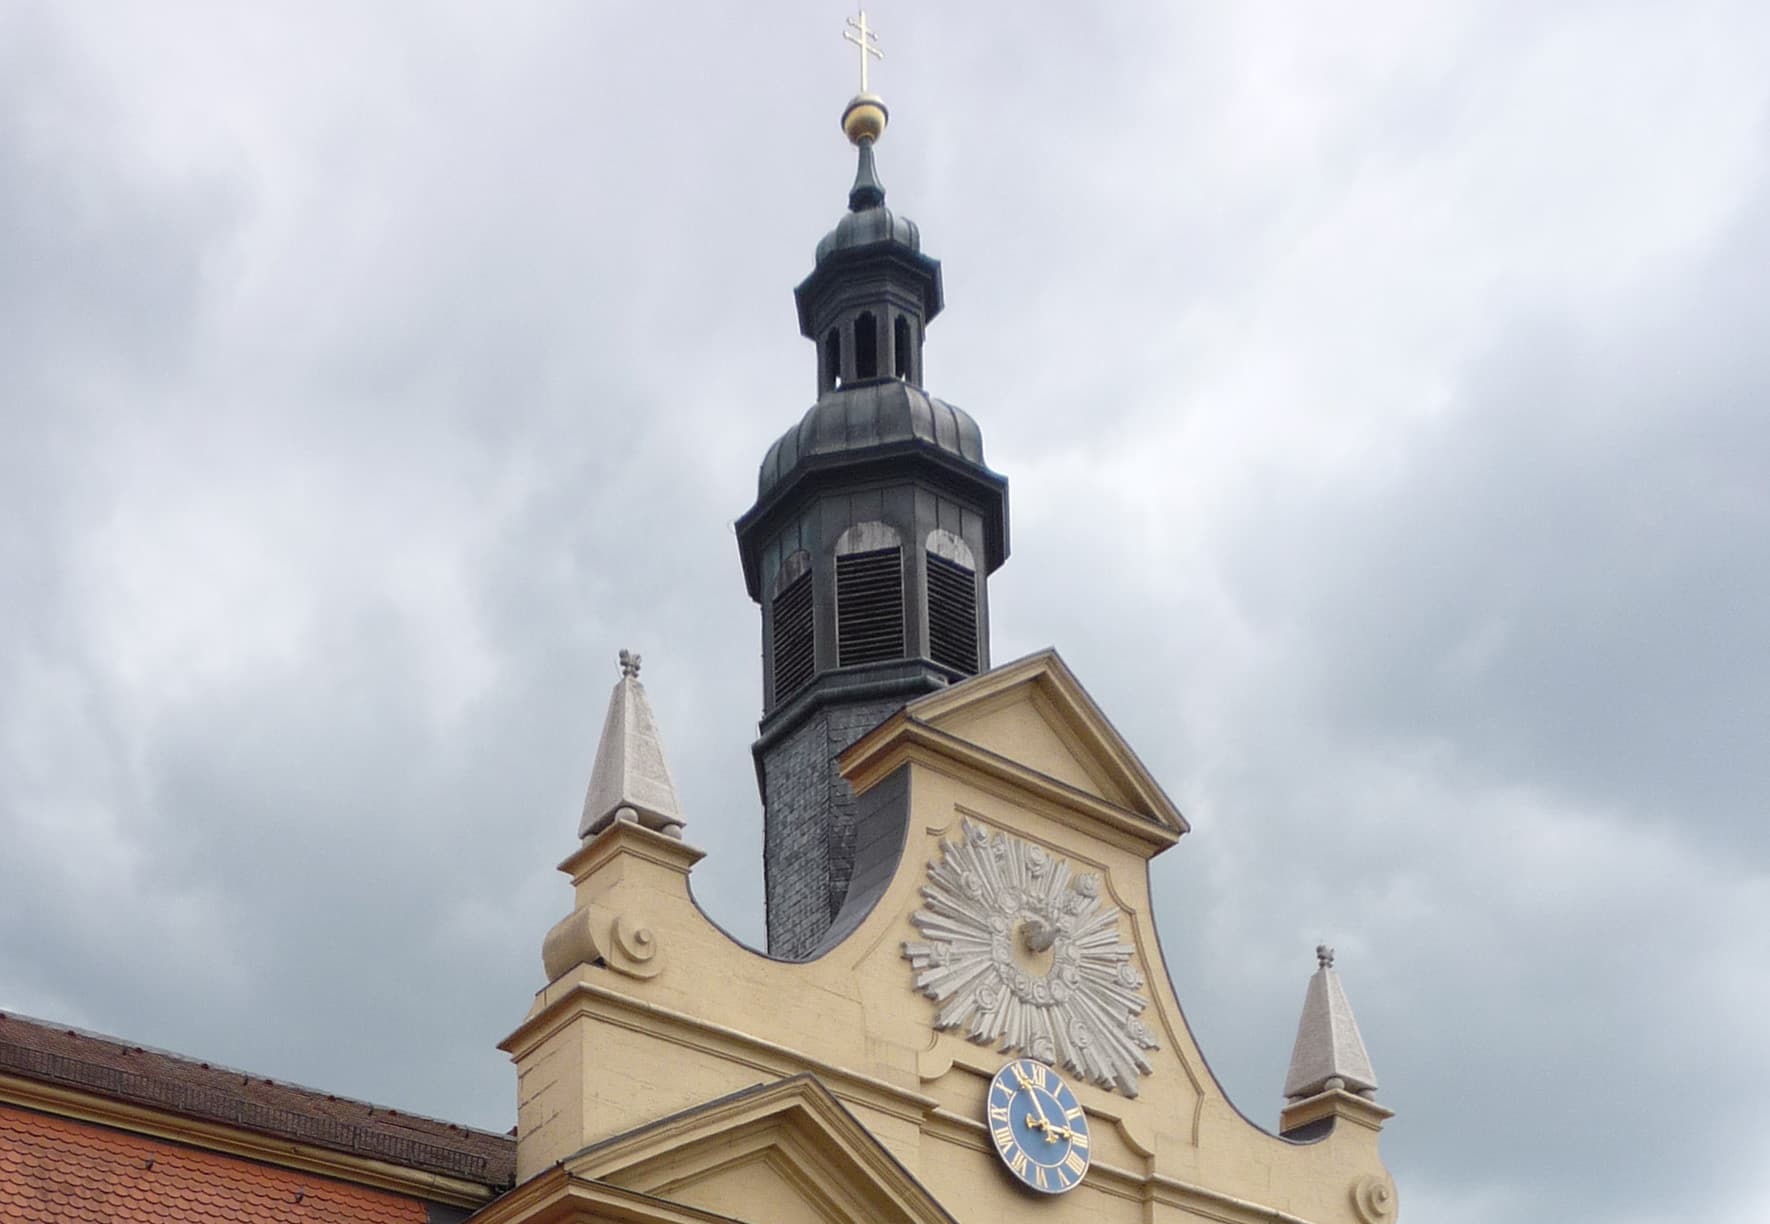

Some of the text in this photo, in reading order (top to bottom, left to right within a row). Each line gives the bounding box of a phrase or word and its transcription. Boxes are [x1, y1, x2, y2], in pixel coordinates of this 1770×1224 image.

[1031, 1063, 1046, 1088] XII
[996, 1077, 1014, 1099] X
[1054, 1081, 1064, 1098] I
[991, 1103, 1008, 1122] IX
[1065, 1107, 1082, 1121] II
[995, 1126, 1015, 1155] VIII
[1057, 1167, 1071, 1187] V
